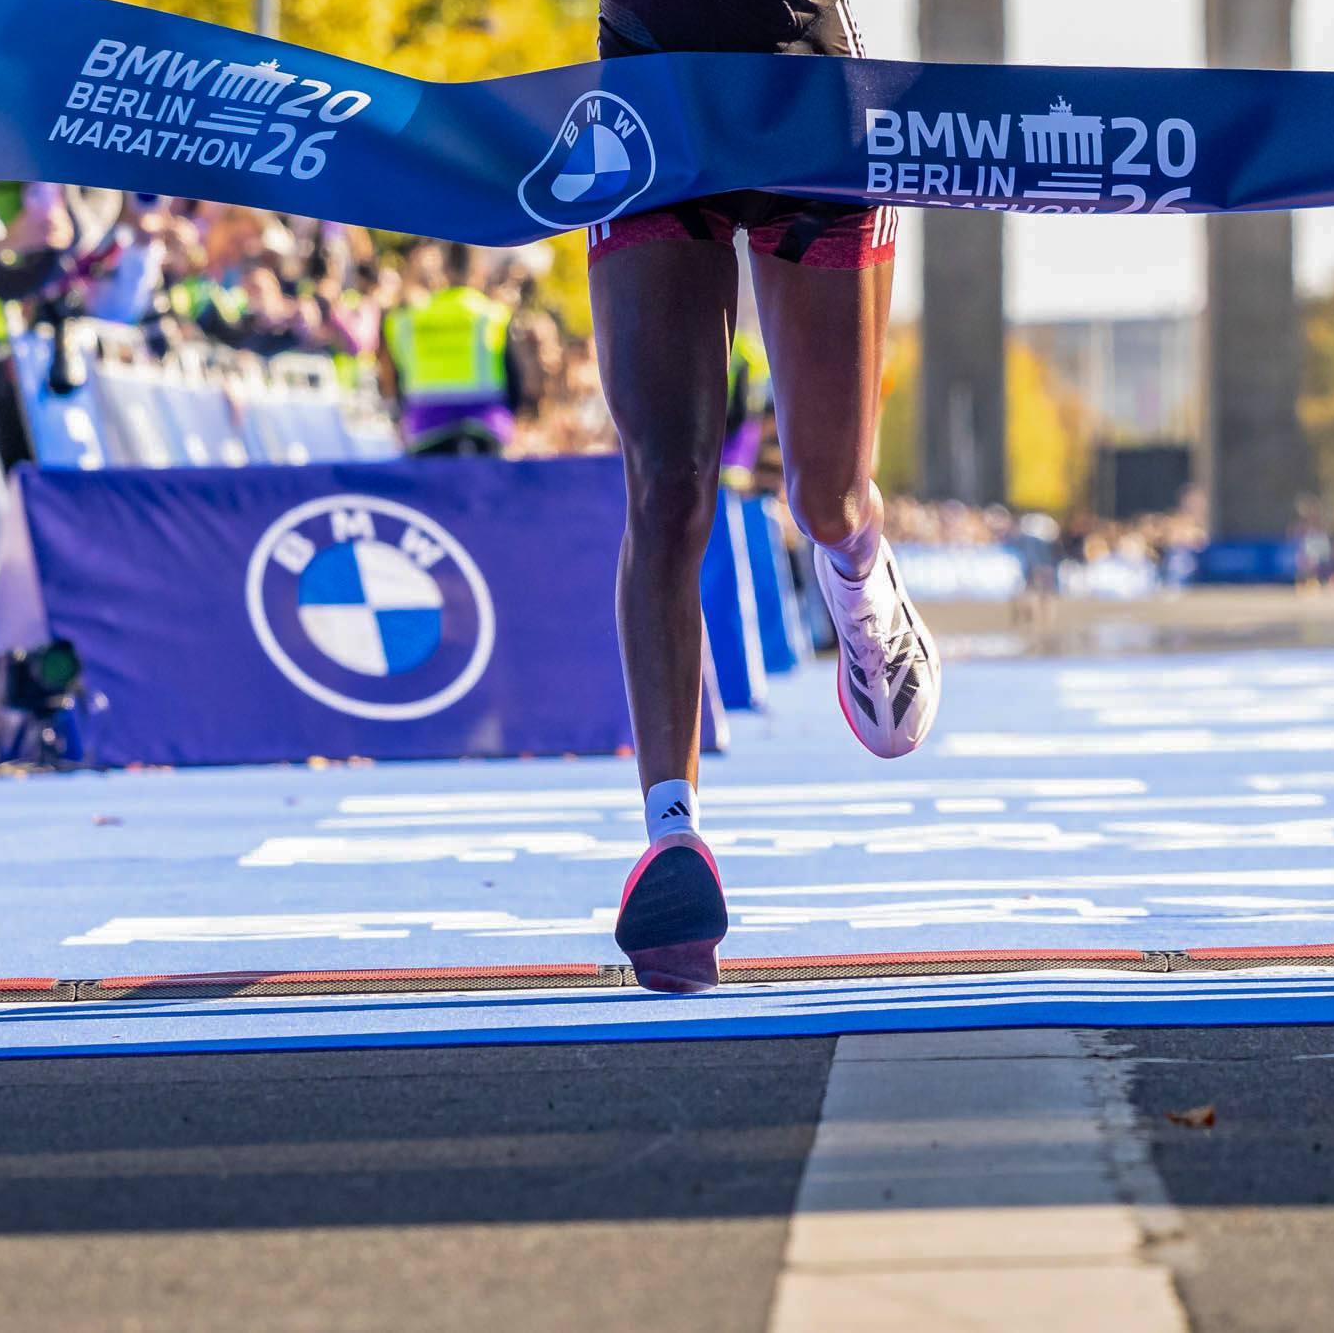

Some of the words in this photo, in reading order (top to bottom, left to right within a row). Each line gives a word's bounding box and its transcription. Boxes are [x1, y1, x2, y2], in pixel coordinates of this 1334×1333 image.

[65, 81, 196, 127] BERLIN
[80, 38, 222, 91] BMW
[275, 78, 372, 124] 20
[48, 114, 253, 171] MARATHON
[249, 122, 338, 180] 26
[563, 99, 637, 149] BMW
[865, 108, 1012, 159] BMW
[1110, 116, 1197, 178] 20
[866, 161, 1016, 198] BERLIN
[271, 507, 449, 574] BMW
